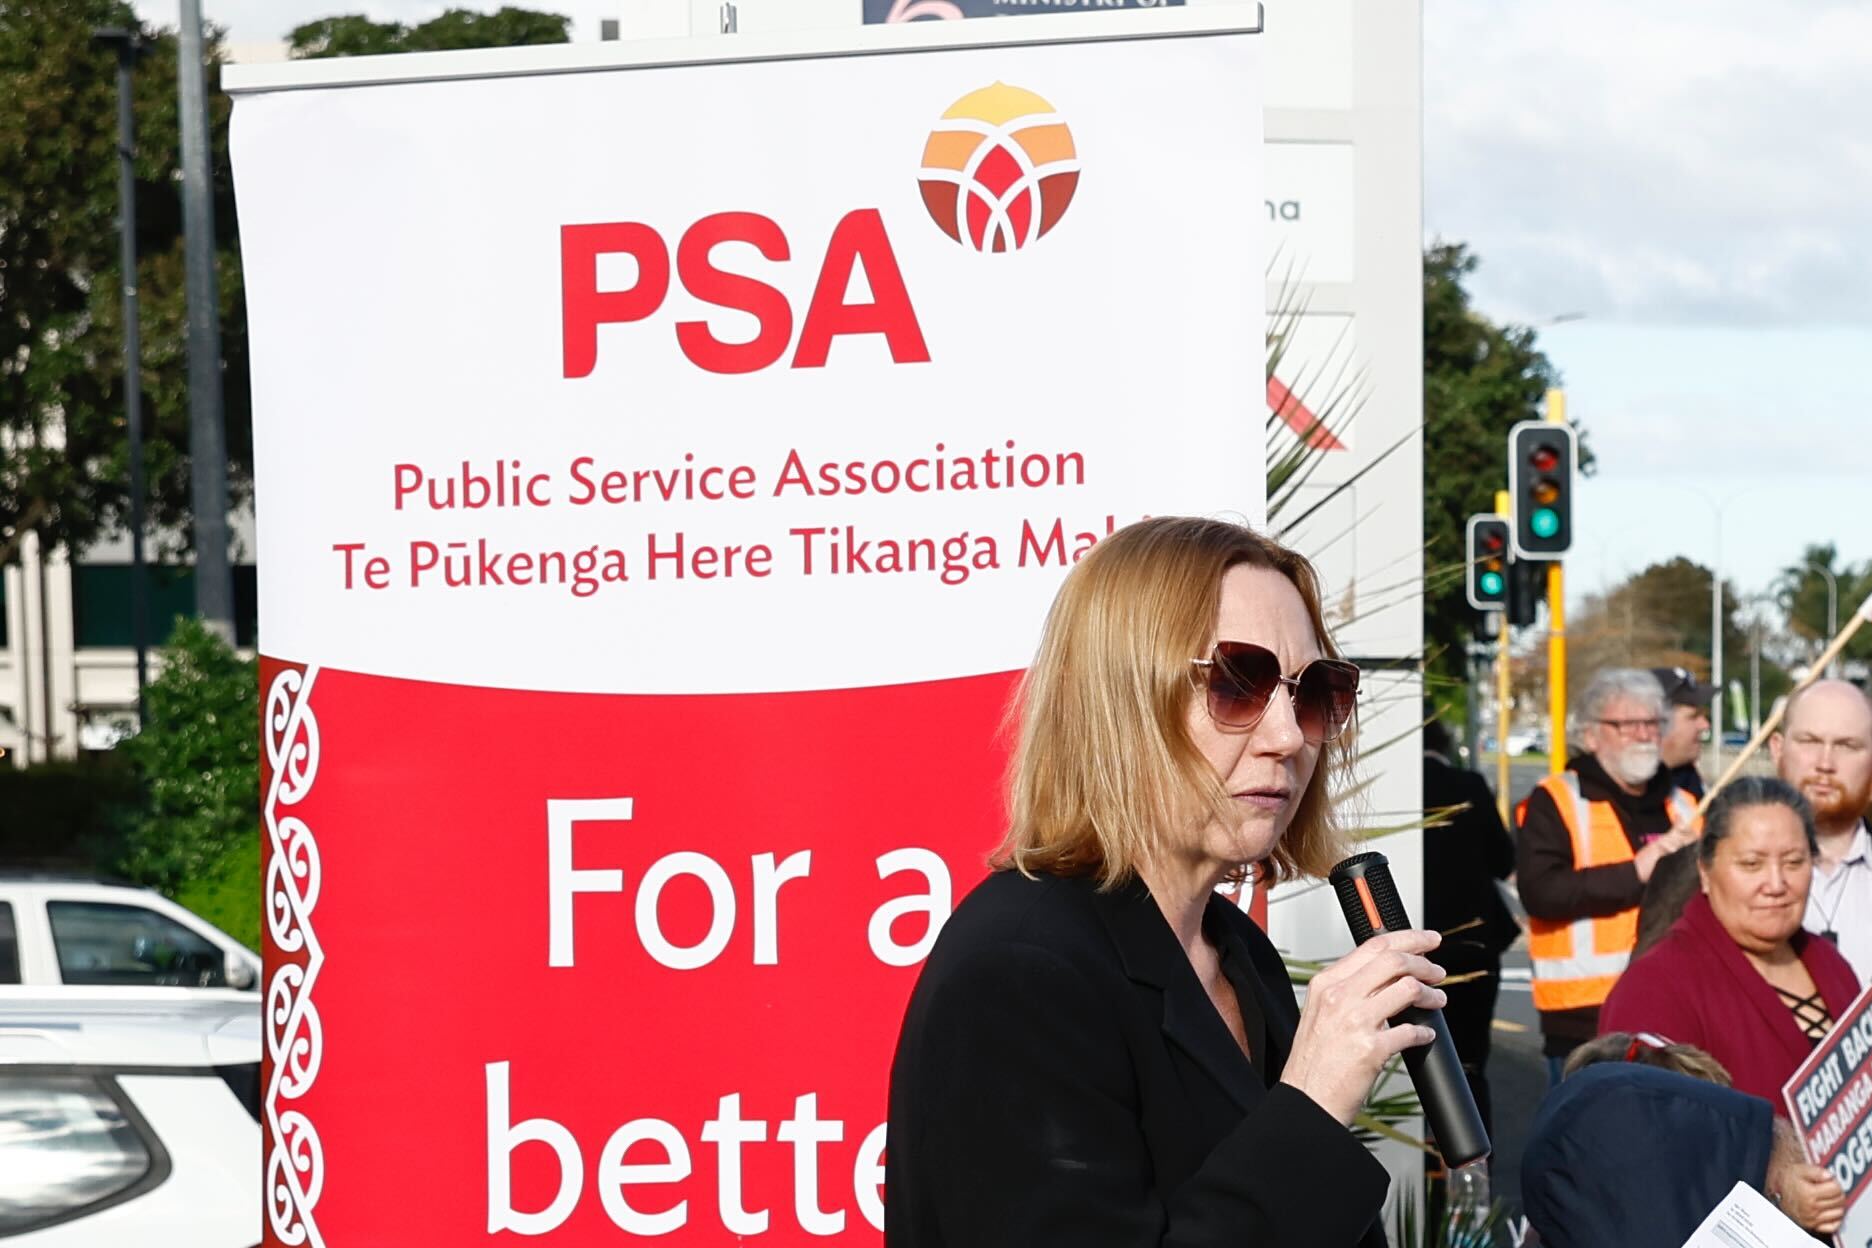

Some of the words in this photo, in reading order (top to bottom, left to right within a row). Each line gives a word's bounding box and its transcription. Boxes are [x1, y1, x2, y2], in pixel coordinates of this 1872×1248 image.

[561, 208, 931, 379] PSA
[393, 458, 551, 511] Public
[569, 454, 758, 506] Service
[773, 441, 1085, 497] Association
[332, 539, 391, 592] Te
[410, 535, 630, 599] Pūkenga
[648, 530, 773, 580] Here
[789, 523, 1001, 586] Tikanga
[546, 797, 811, 970] For
[867, 847, 952, 967] a
[1796, 1053, 1845, 1125] FIGHT
